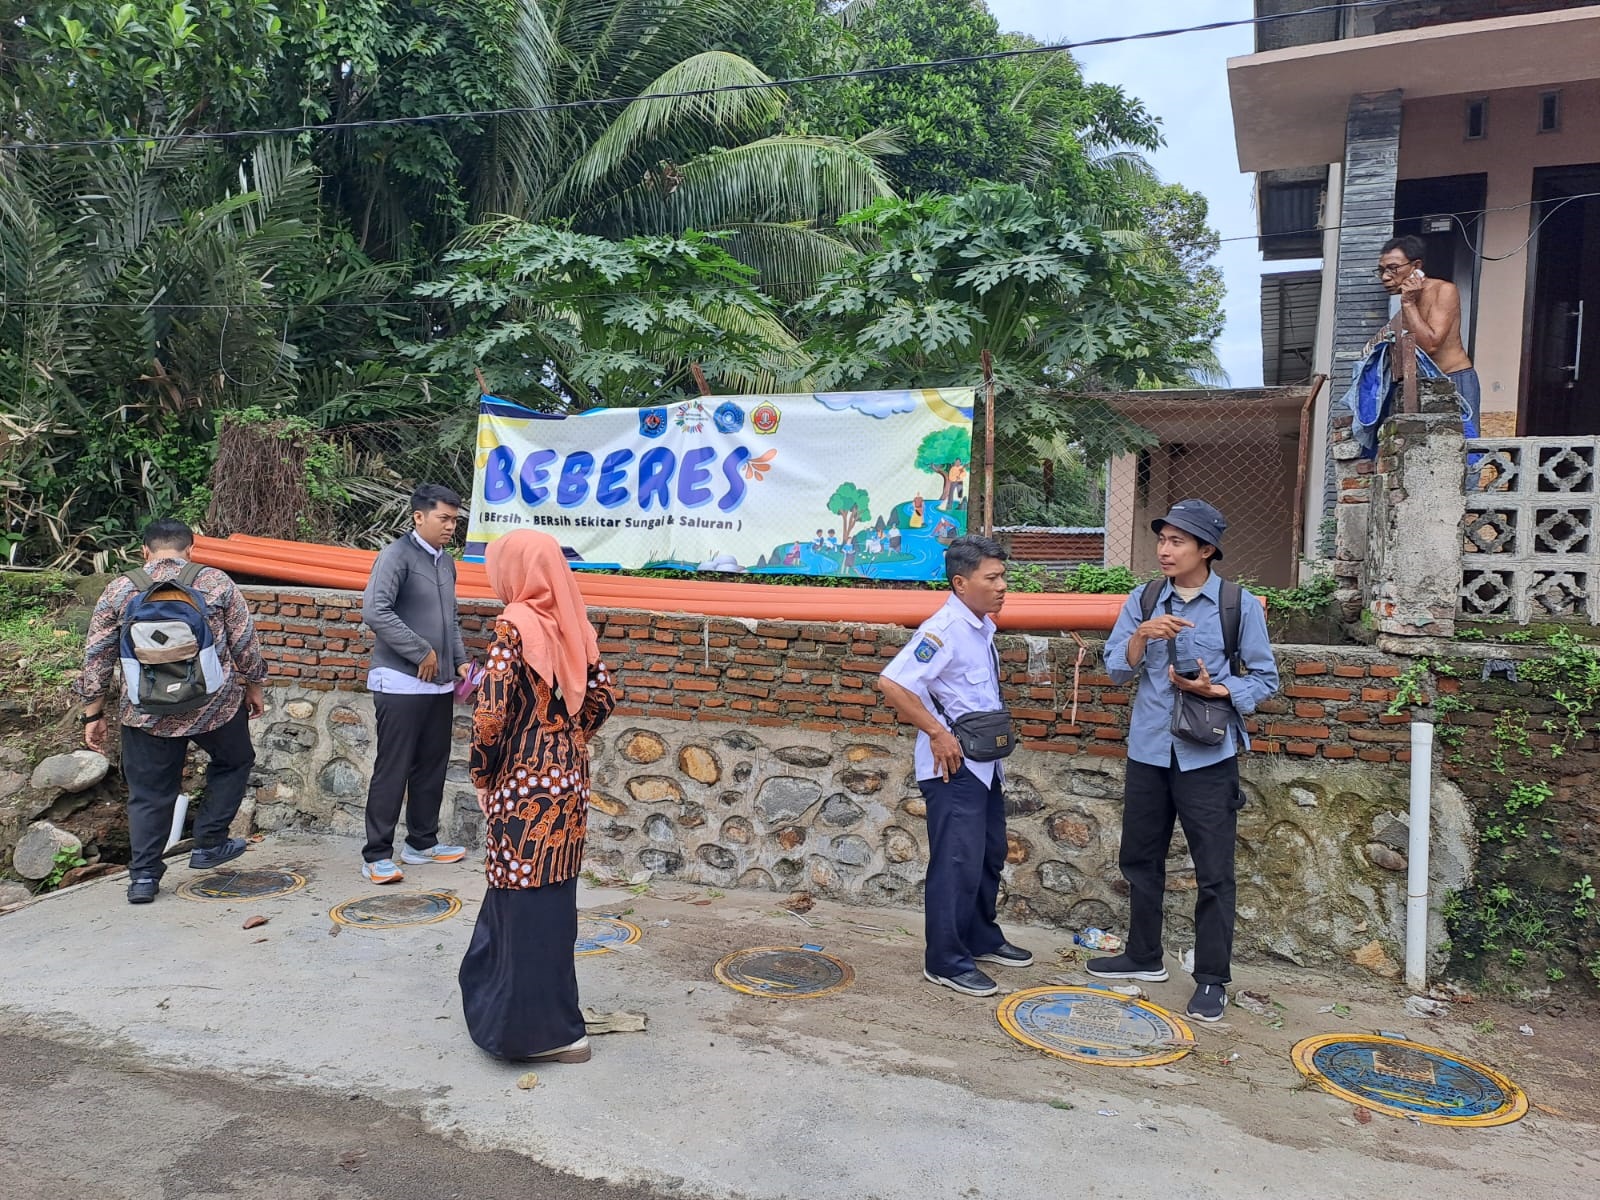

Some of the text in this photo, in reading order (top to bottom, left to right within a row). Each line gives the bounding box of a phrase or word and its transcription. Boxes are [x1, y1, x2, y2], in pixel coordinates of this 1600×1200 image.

[484, 445, 751, 513] BEBERES
[533, 515, 571, 526] BERsih
[575, 516, 621, 527] sEkitar
[625, 515, 665, 530] Sungai
[667, 515, 674, 525] &
[679, 516, 733, 529] Saluran
